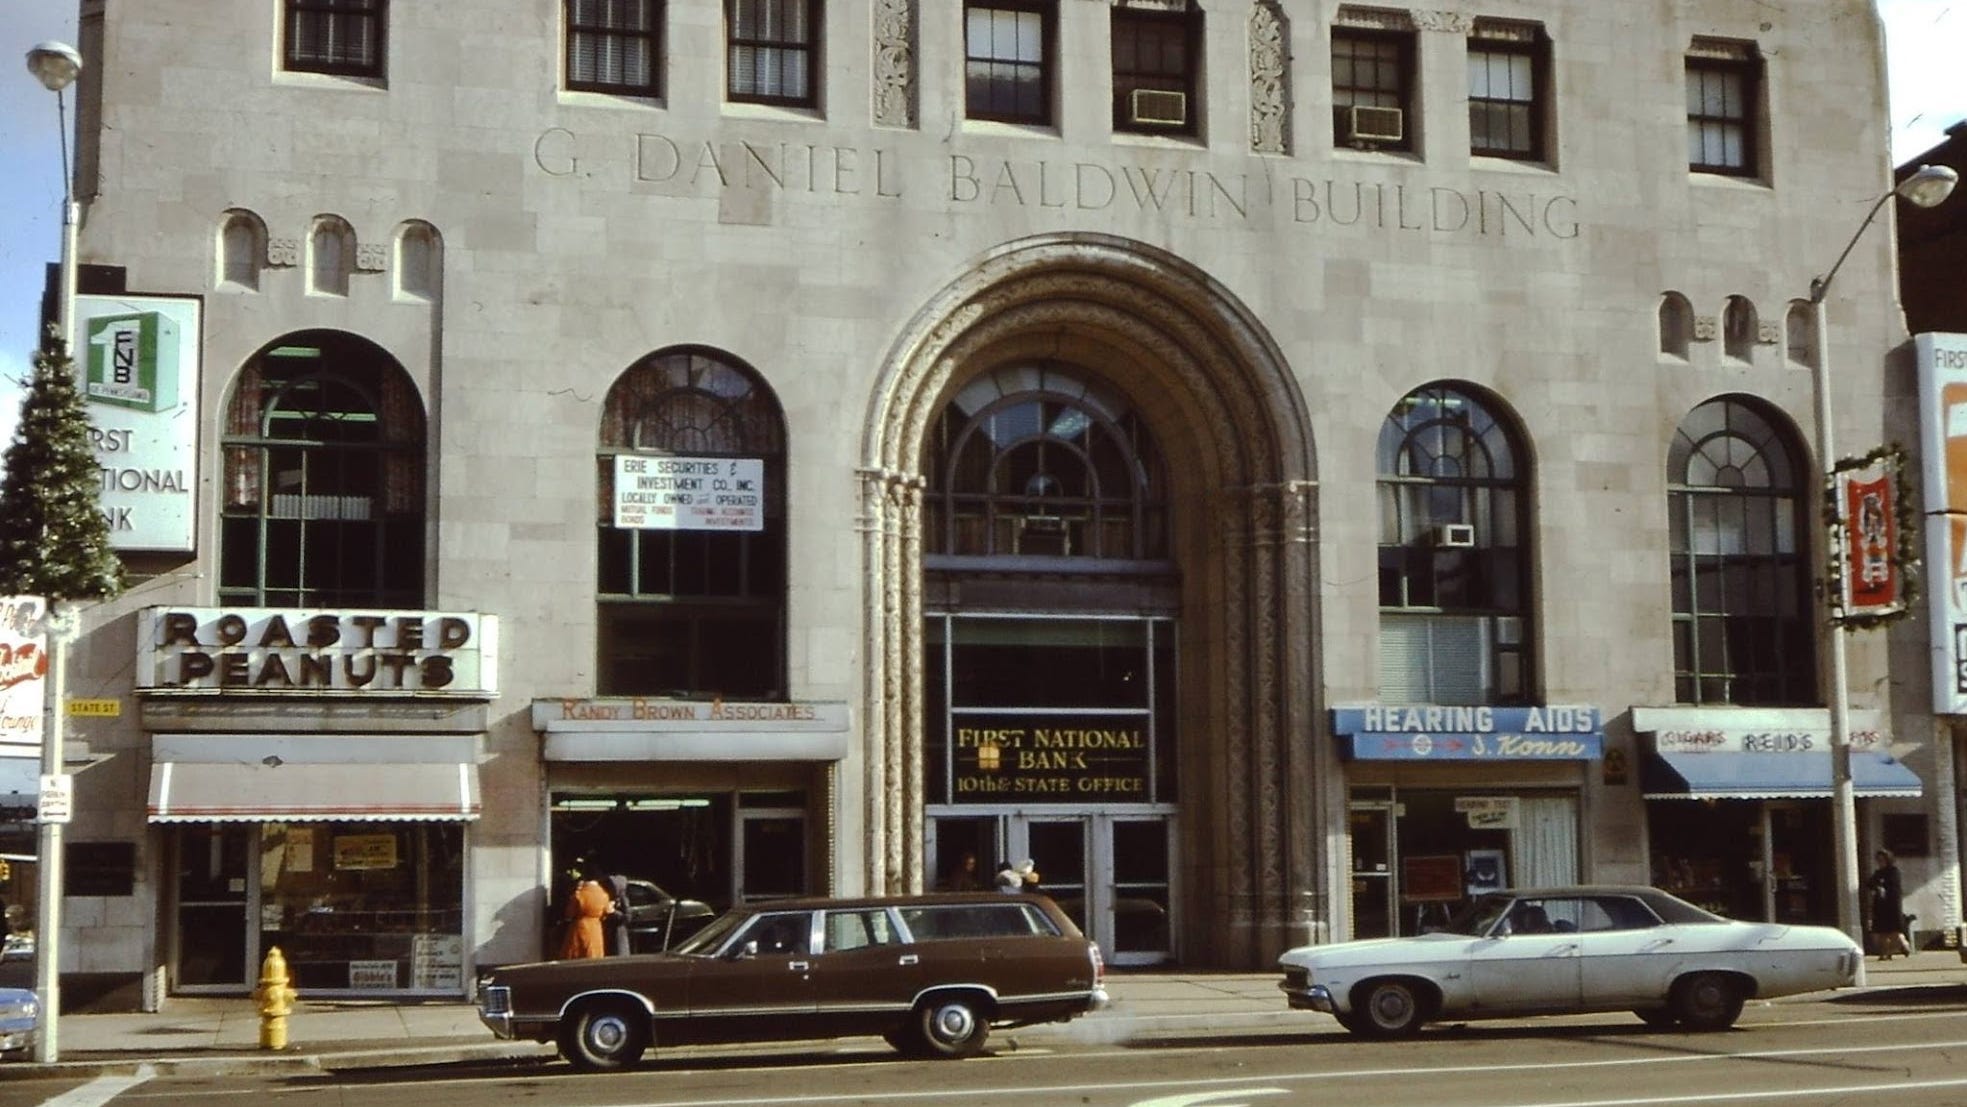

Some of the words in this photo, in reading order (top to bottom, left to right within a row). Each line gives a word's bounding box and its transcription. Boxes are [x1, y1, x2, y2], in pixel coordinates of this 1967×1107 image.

[534, 127, 593, 177] G.
[635, 132, 901, 199] DANIEL
[951, 154, 1248, 220] BALDWIN
[1291, 176, 1581, 240] BUILDING
[87, 427, 133, 453] RST
[624, 460, 647, 473] ERIE
[657, 461, 718, 475] SECURITIES
[100, 468, 189, 493] TIONAL
[637, 476, 704, 491] INVESTMENT
[622, 492, 657, 504] LOCALLY
[664, 493, 693, 505] OWNED
[716, 495, 758, 507] OPERATED
[100, 507, 133, 531] NK
[163, 612, 471, 650] ROASTED
[174, 652, 455, 687] PEANUTS
[71, 703, 100, 713] STATE
[103, 703, 114, 713] ST
[1364, 706, 1494, 733] HEARING
[1524, 706, 1594, 733] AIDS
[958, 728, 1025, 749] FIRST
[1034, 729, 1144, 748] NATIONAL
[1018, 751, 1088, 769] BANK
[1014, 777, 1071, 792] STATE
[1077, 777, 1143, 792] OFFICE
